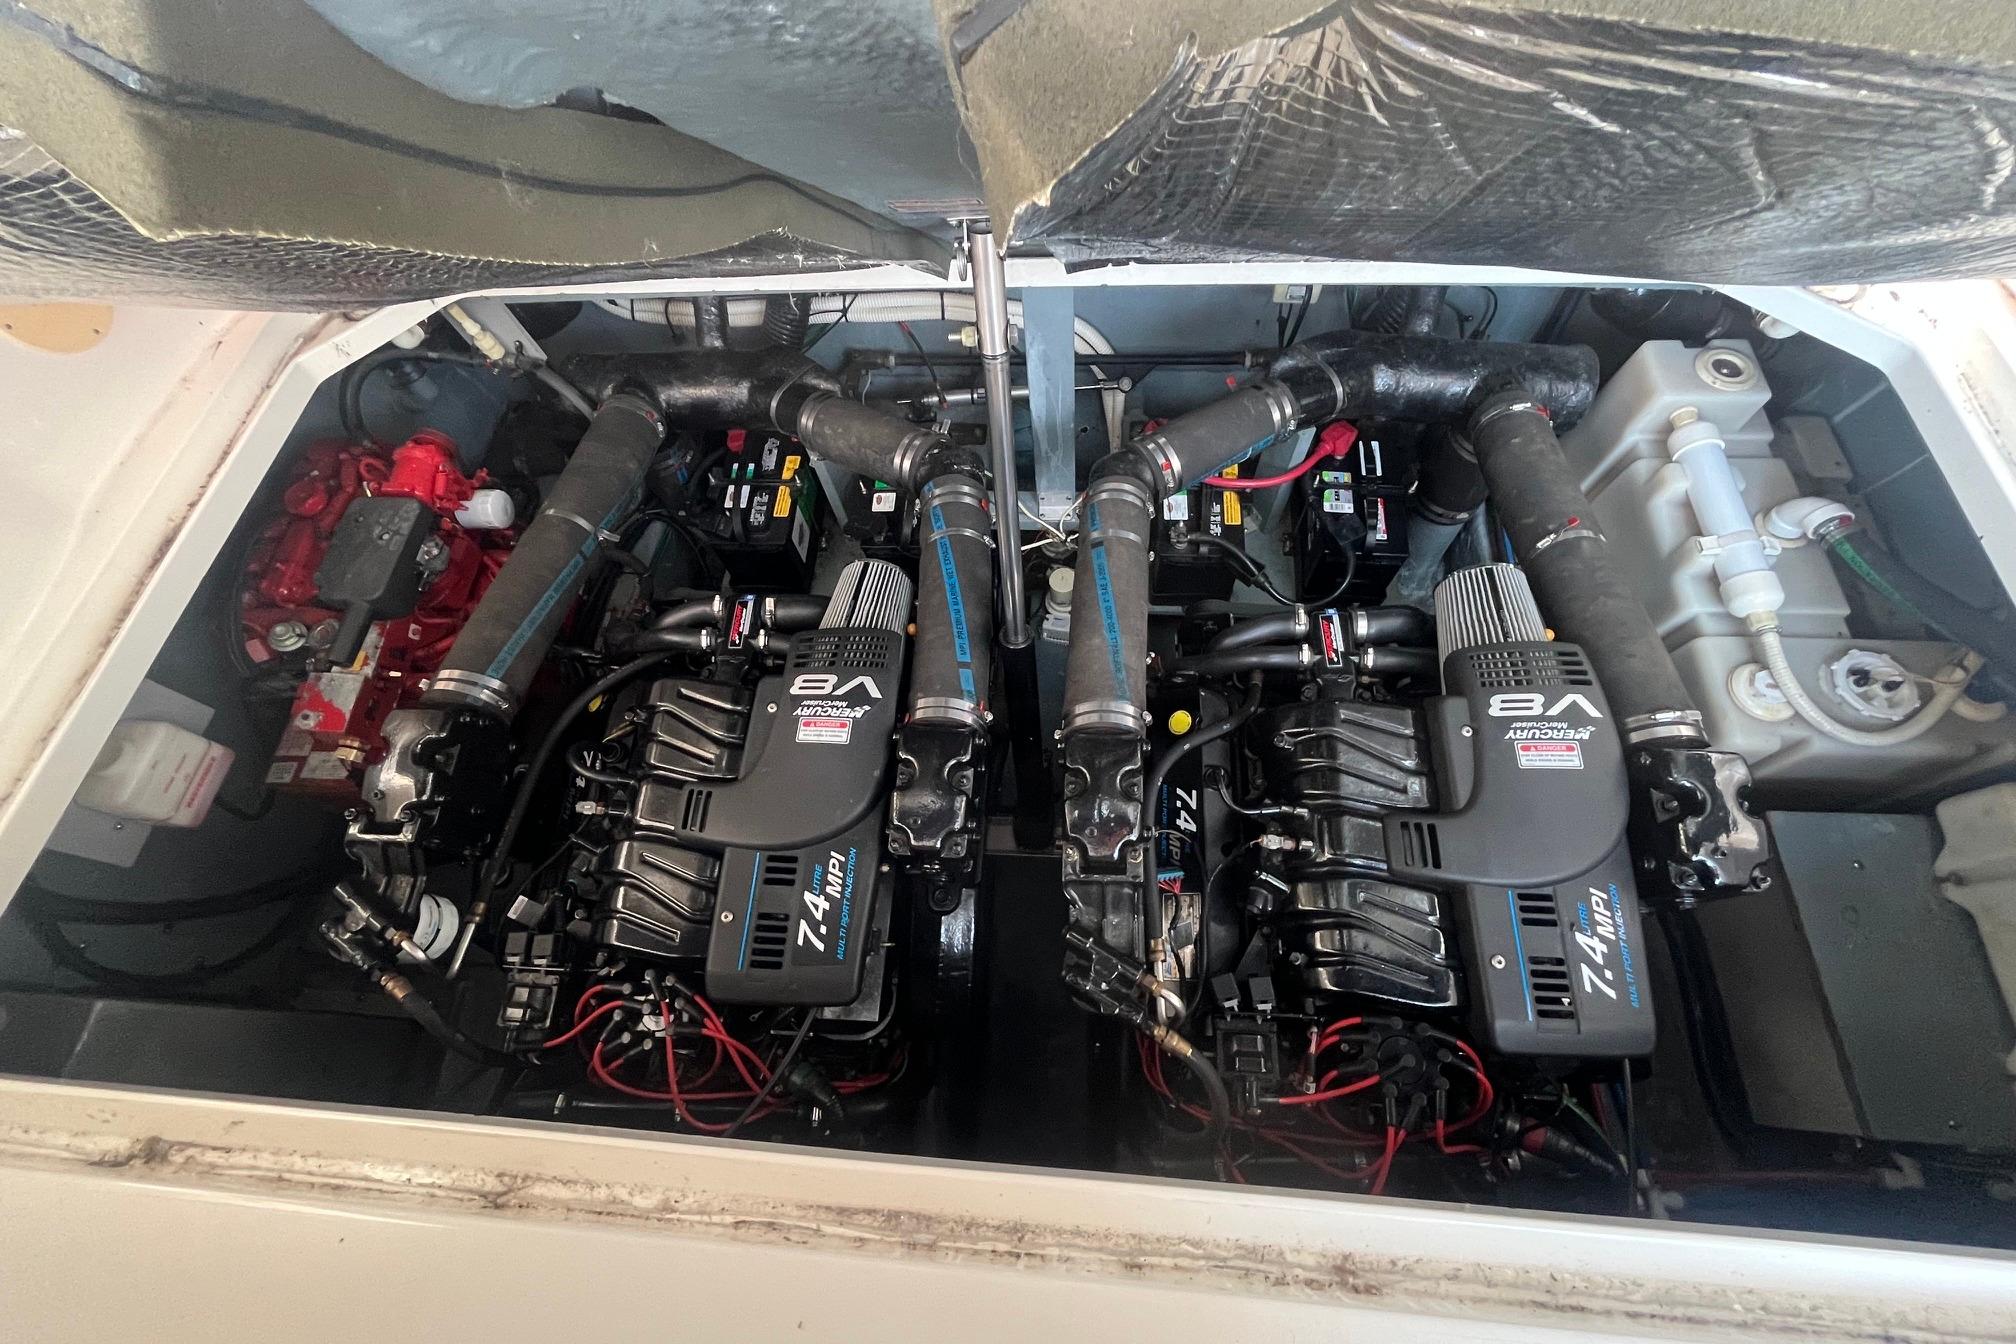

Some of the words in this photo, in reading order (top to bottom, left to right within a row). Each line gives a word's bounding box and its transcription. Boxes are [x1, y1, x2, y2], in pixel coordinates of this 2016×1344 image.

[947, 581, 959, 606] MARINE
[953, 608, 965, 640] PREMIUM
[789, 673, 883, 699] V8
[792, 705, 872, 719] MERCURY
[801, 699, 848, 708] MerCruiser
[1488, 692, 1604, 718] V8
[1503, 725, 1596, 740] MERCURY
[1510, 721, 1568, 729] MerCruiser
[1175, 787, 1197, 833] 7.4
[812, 863, 823, 896] LITRE
[825, 851, 846, 899] MPI
[843, 847, 857, 898] INJECTION
[797, 890, 830, 953] 7.4
[840, 897, 851, 928] PORT
[1577, 901, 1592, 936] LITRE
[1589, 887, 1616, 941] MPI
[1608, 883, 1627, 939] INJECTION
[836, 928, 847, 961] MULTI
[1619, 940, 1633, 972] PORT
[1574, 931, 1617, 1000] 7.4
[1626, 974, 1640, 1008] MULTI
